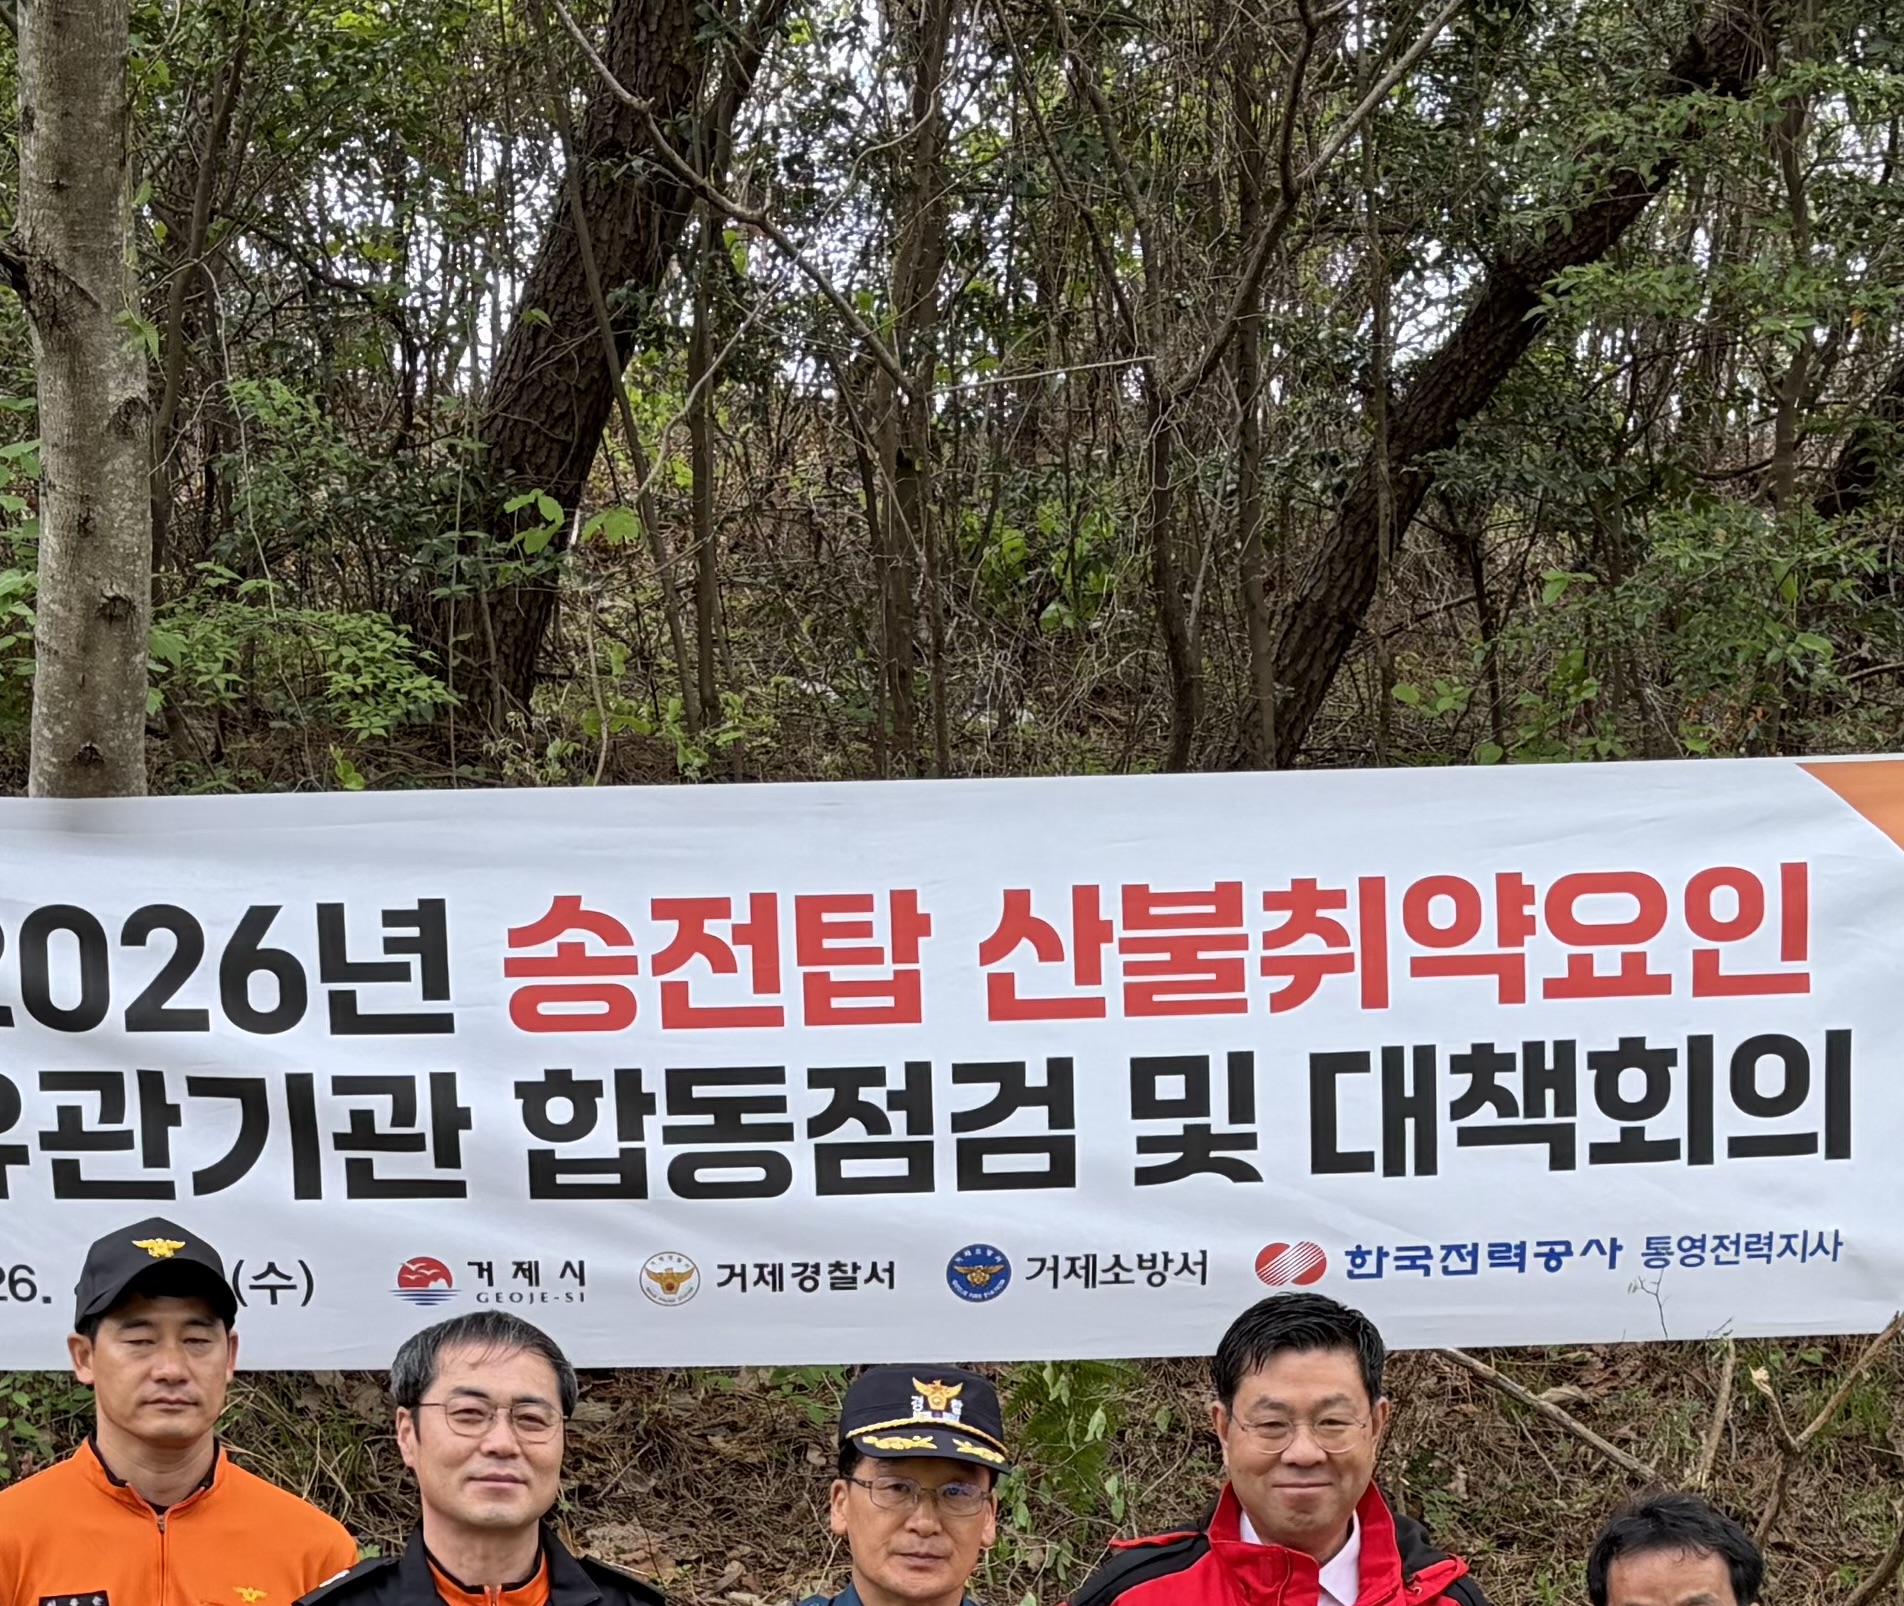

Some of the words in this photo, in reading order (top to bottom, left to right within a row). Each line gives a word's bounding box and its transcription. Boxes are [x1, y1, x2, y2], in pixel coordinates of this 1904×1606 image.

[504, 890, 932, 1033] 송전탑
[979, 862, 1812, 1022] 산불취약요인
[514, 1056, 1077, 1200] 합동점검
[1129, 1050, 1265, 1187] 및
[1309, 1028, 1853, 1178] 대책회의
[467, 1260, 586, 1287] 거제시
[716, 1260, 895, 1293] 거제경찰서
[1025, 1249, 1208, 1290] 거제소방서
[1345, 1237, 1624, 1280] 한국전력공사
[1640, 1229, 1844, 1269] 통영전력지사
[230, 1259, 314, 1307] (수)
[476, 1291, 585, 1304] GEOJE-SI
